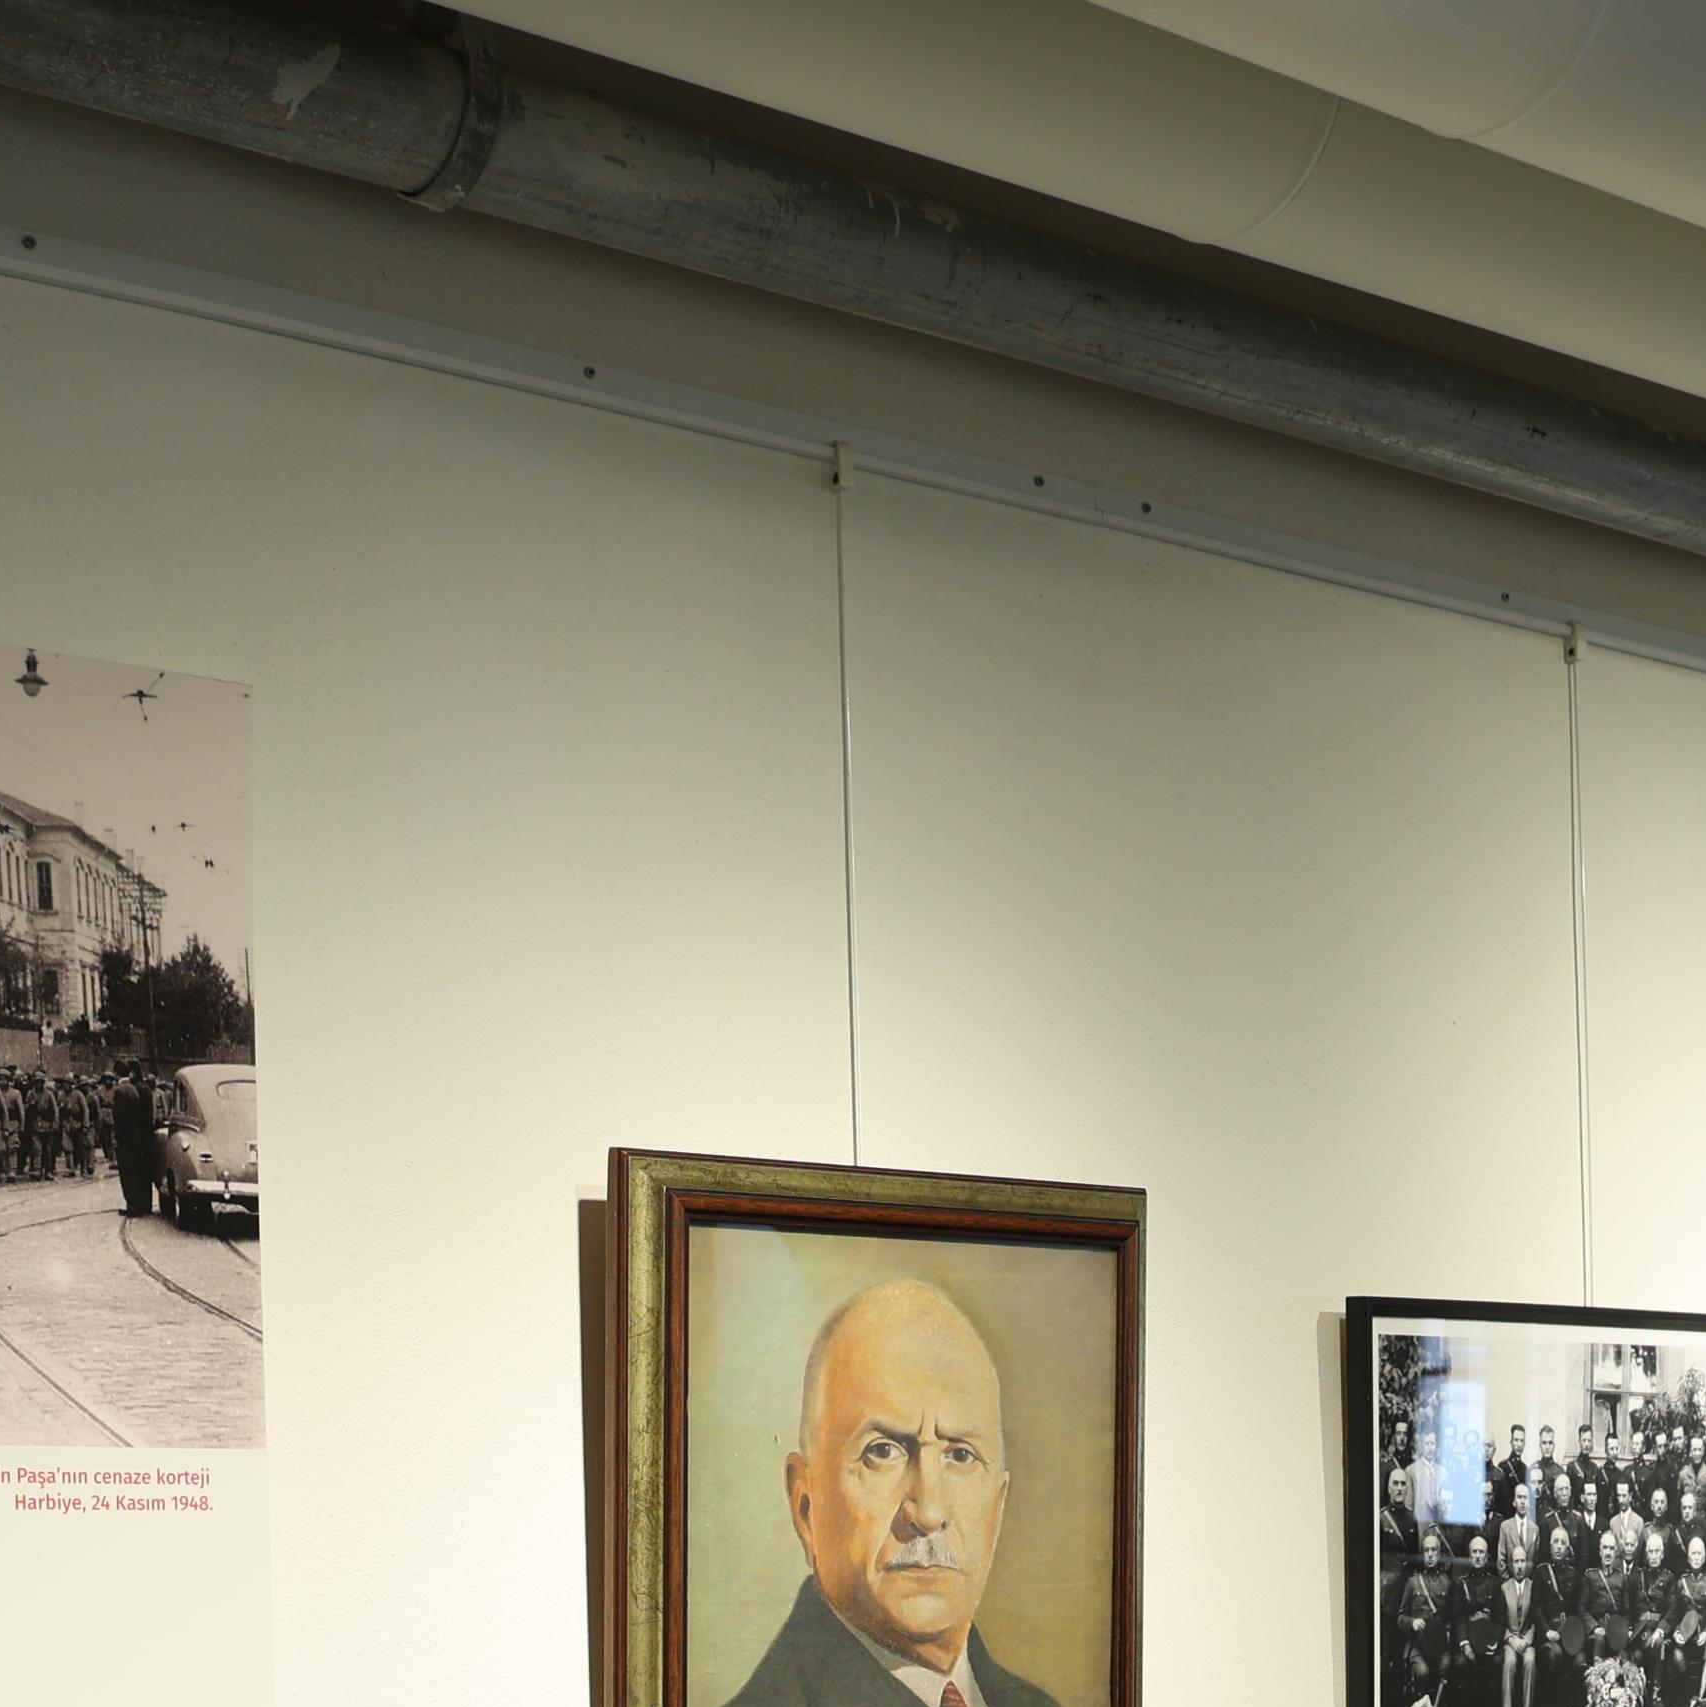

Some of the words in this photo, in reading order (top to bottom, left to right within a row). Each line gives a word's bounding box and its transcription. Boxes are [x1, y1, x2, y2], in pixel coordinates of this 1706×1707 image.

[16, 1466, 88, 1490] Paşa’nın
[92, 1471, 152, 1485] cenaze
[156, 1467, 210, 1490] korteji
[14, 1491, 87, 1515] Harbiye,
[90, 1494, 111, 1511] 24
[115, 1494, 166, 1511] Kasım
[170, 1494, 214, 1511] 1948.
